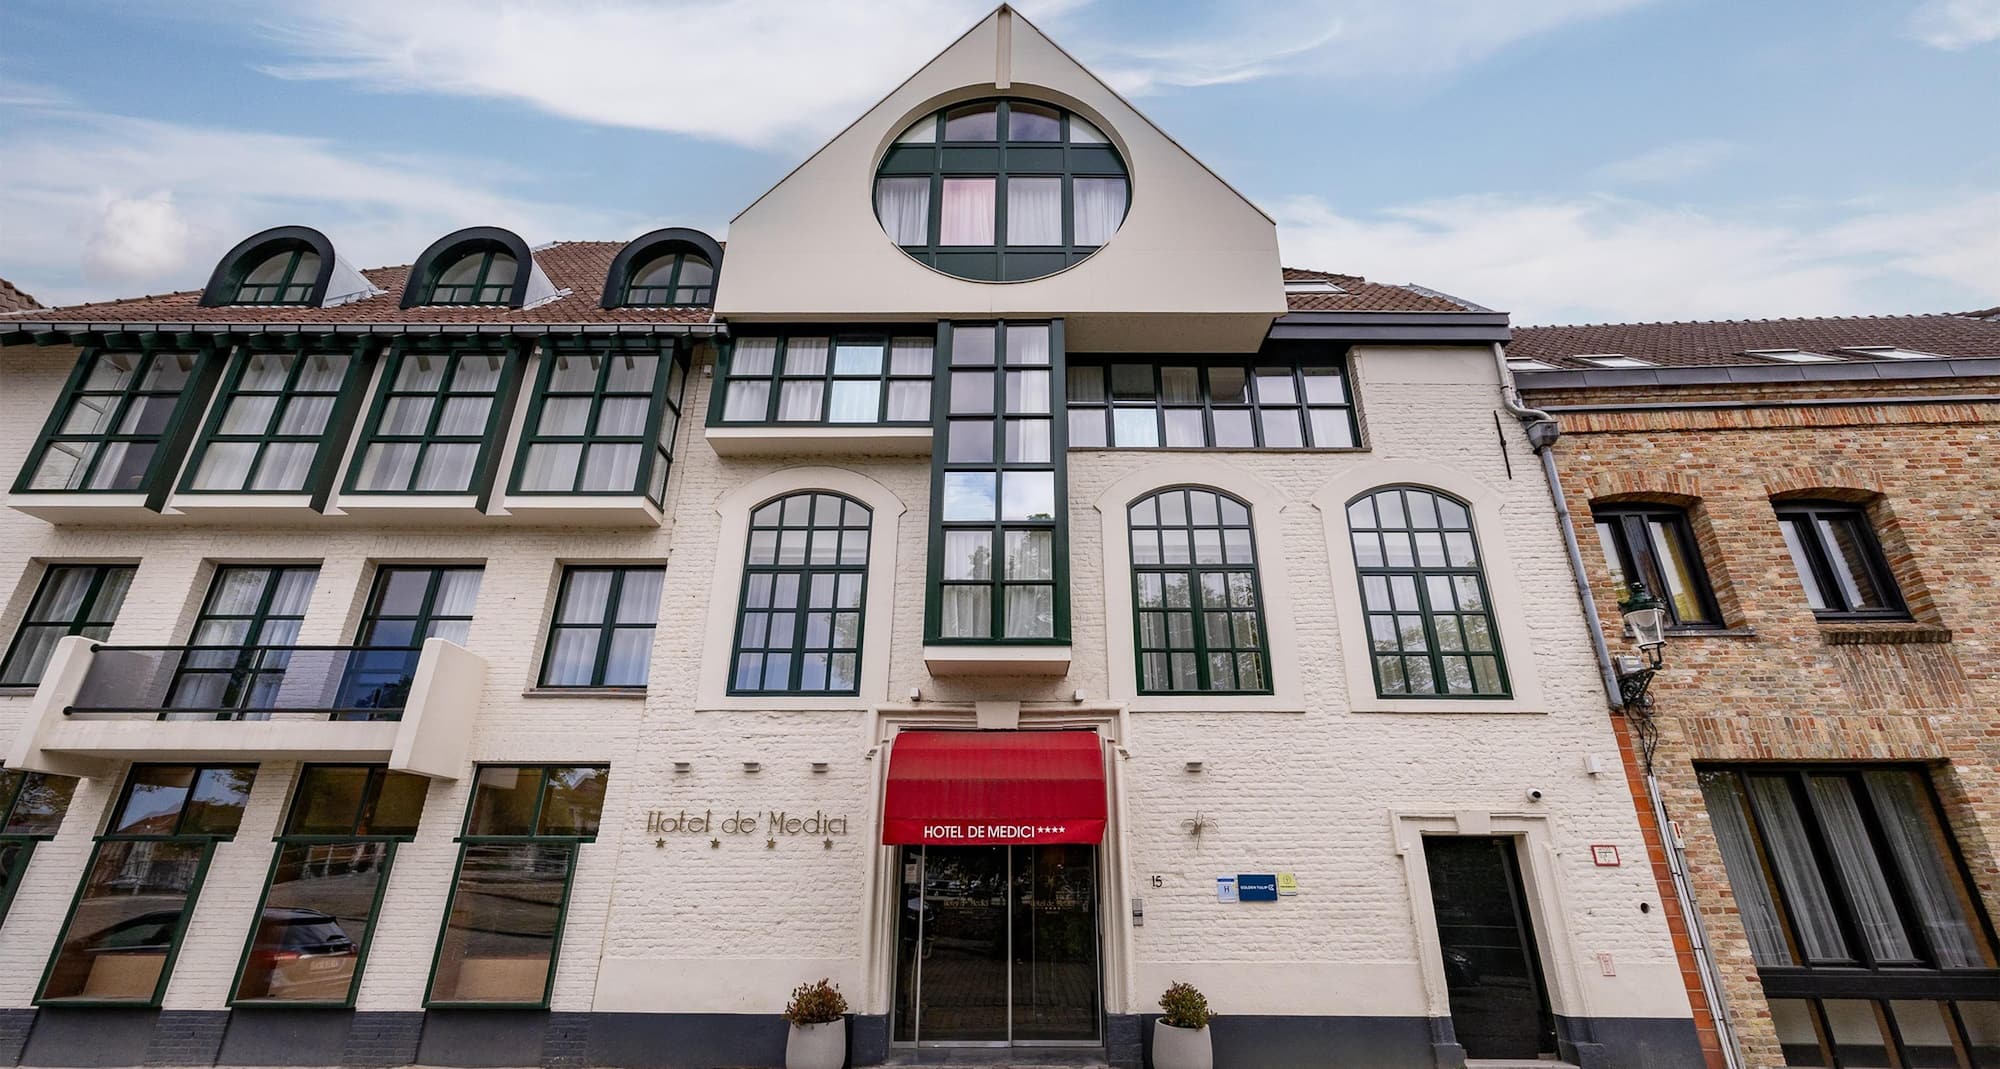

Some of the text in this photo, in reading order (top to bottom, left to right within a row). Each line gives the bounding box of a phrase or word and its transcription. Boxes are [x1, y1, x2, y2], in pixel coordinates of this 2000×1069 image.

[646, 808, 711, 833] Hotel
[769, 809, 848, 836] Medici
[924, 825, 1035, 839] HOTEL DE MEDICI
[1151, 875, 1163, 888] 15
[1223, 885, 1230, 894] H
